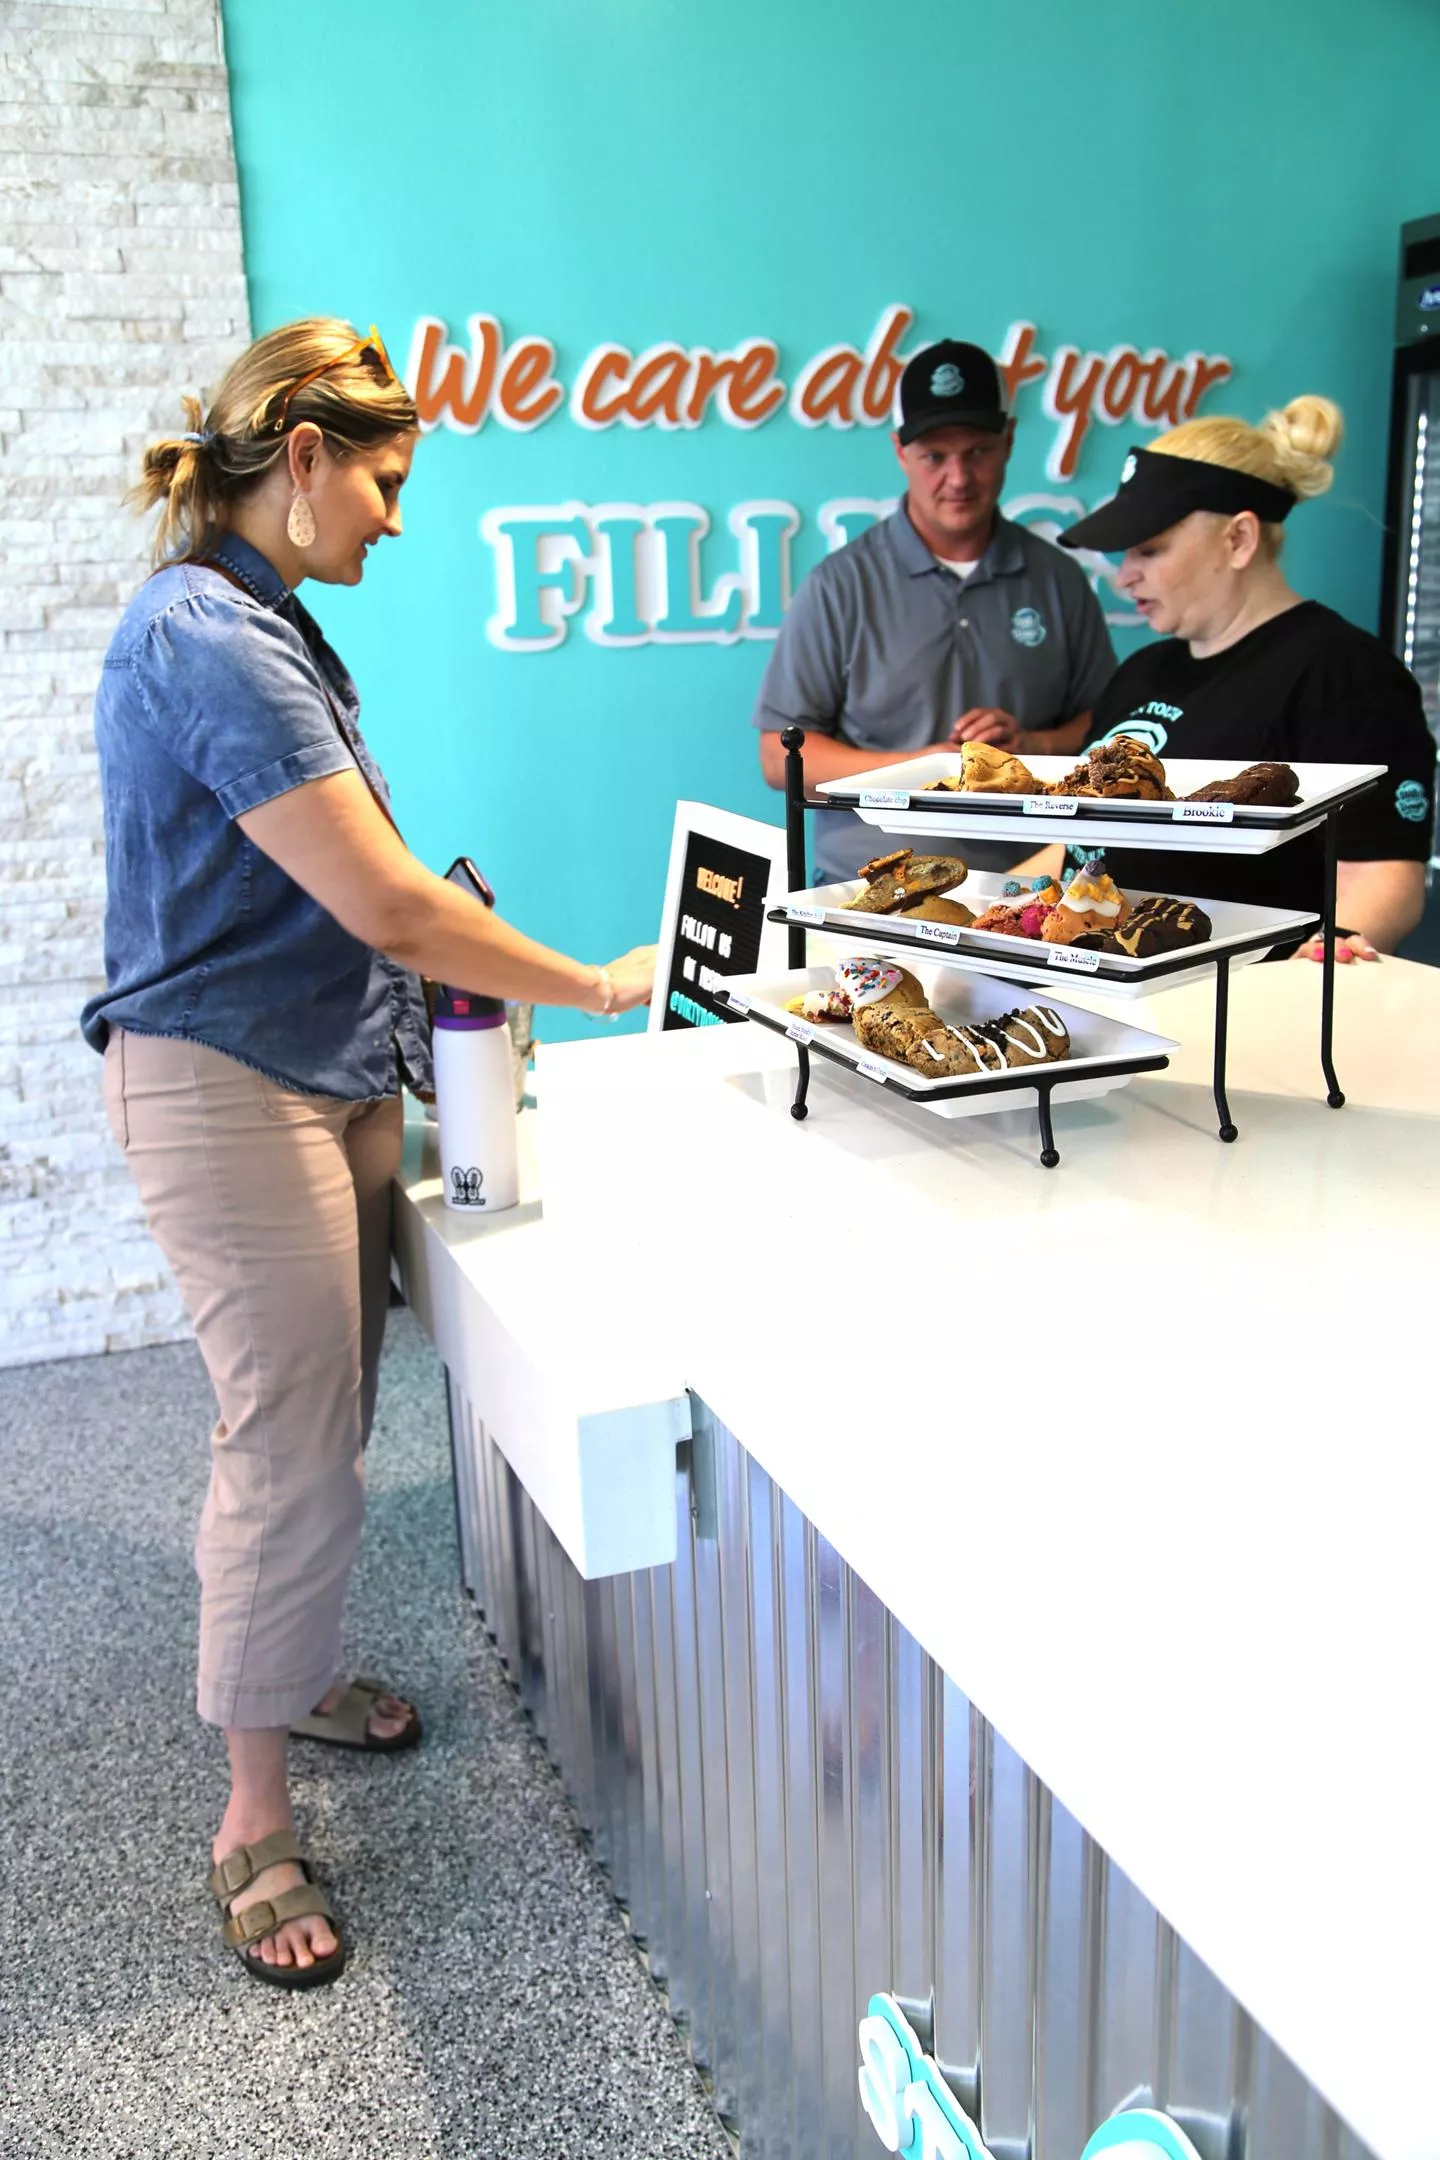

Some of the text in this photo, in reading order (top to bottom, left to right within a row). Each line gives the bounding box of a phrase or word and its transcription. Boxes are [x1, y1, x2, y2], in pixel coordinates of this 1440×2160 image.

[411, 308, 1233, 478] We care abt your
[1030, 800, 1043, 809] The
[1183, 805, 1225, 818] Brookie
[696, 866, 744, 910] WELCOME!
[680, 914, 717, 950] FOLLOW
[920, 924, 958, 941] The Captain
[1054, 951, 1069, 962] The
